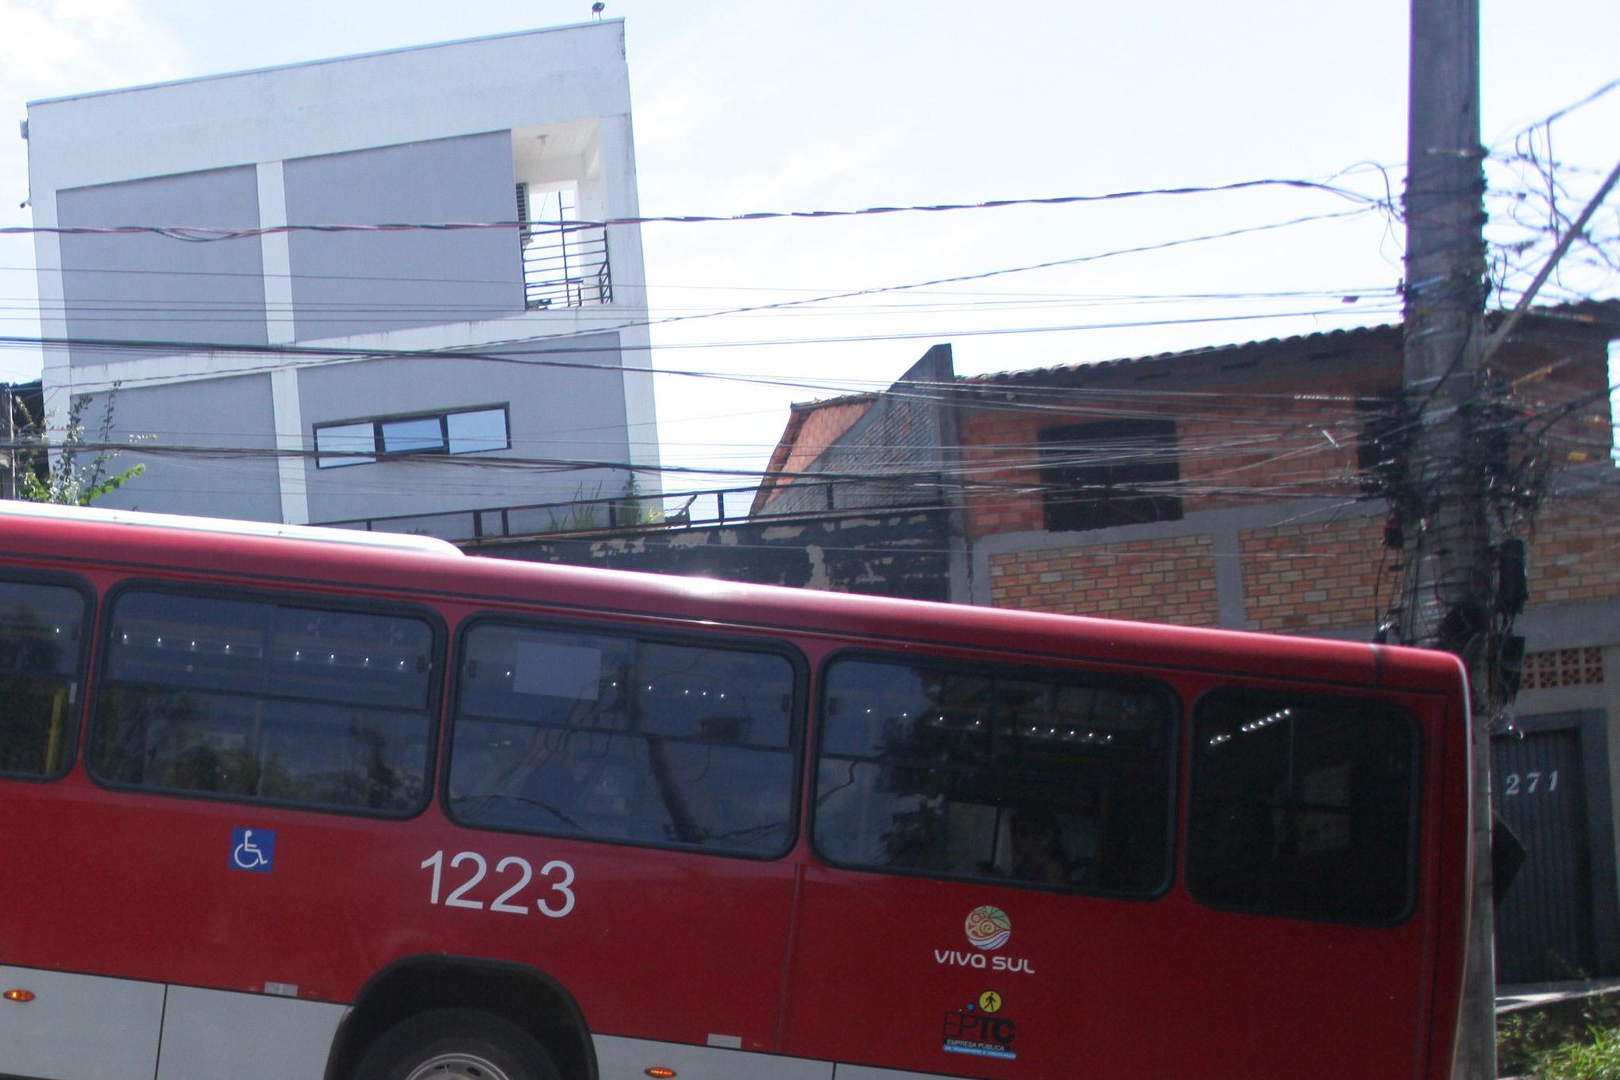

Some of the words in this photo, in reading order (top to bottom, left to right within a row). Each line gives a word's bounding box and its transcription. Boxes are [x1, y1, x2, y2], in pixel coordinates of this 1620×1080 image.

[1505, 770, 1558, 795] 271
[420, 850, 576, 918] 1223
[992, 956, 1036, 974] SUL
[943, 1011, 1016, 1043] EPTC
